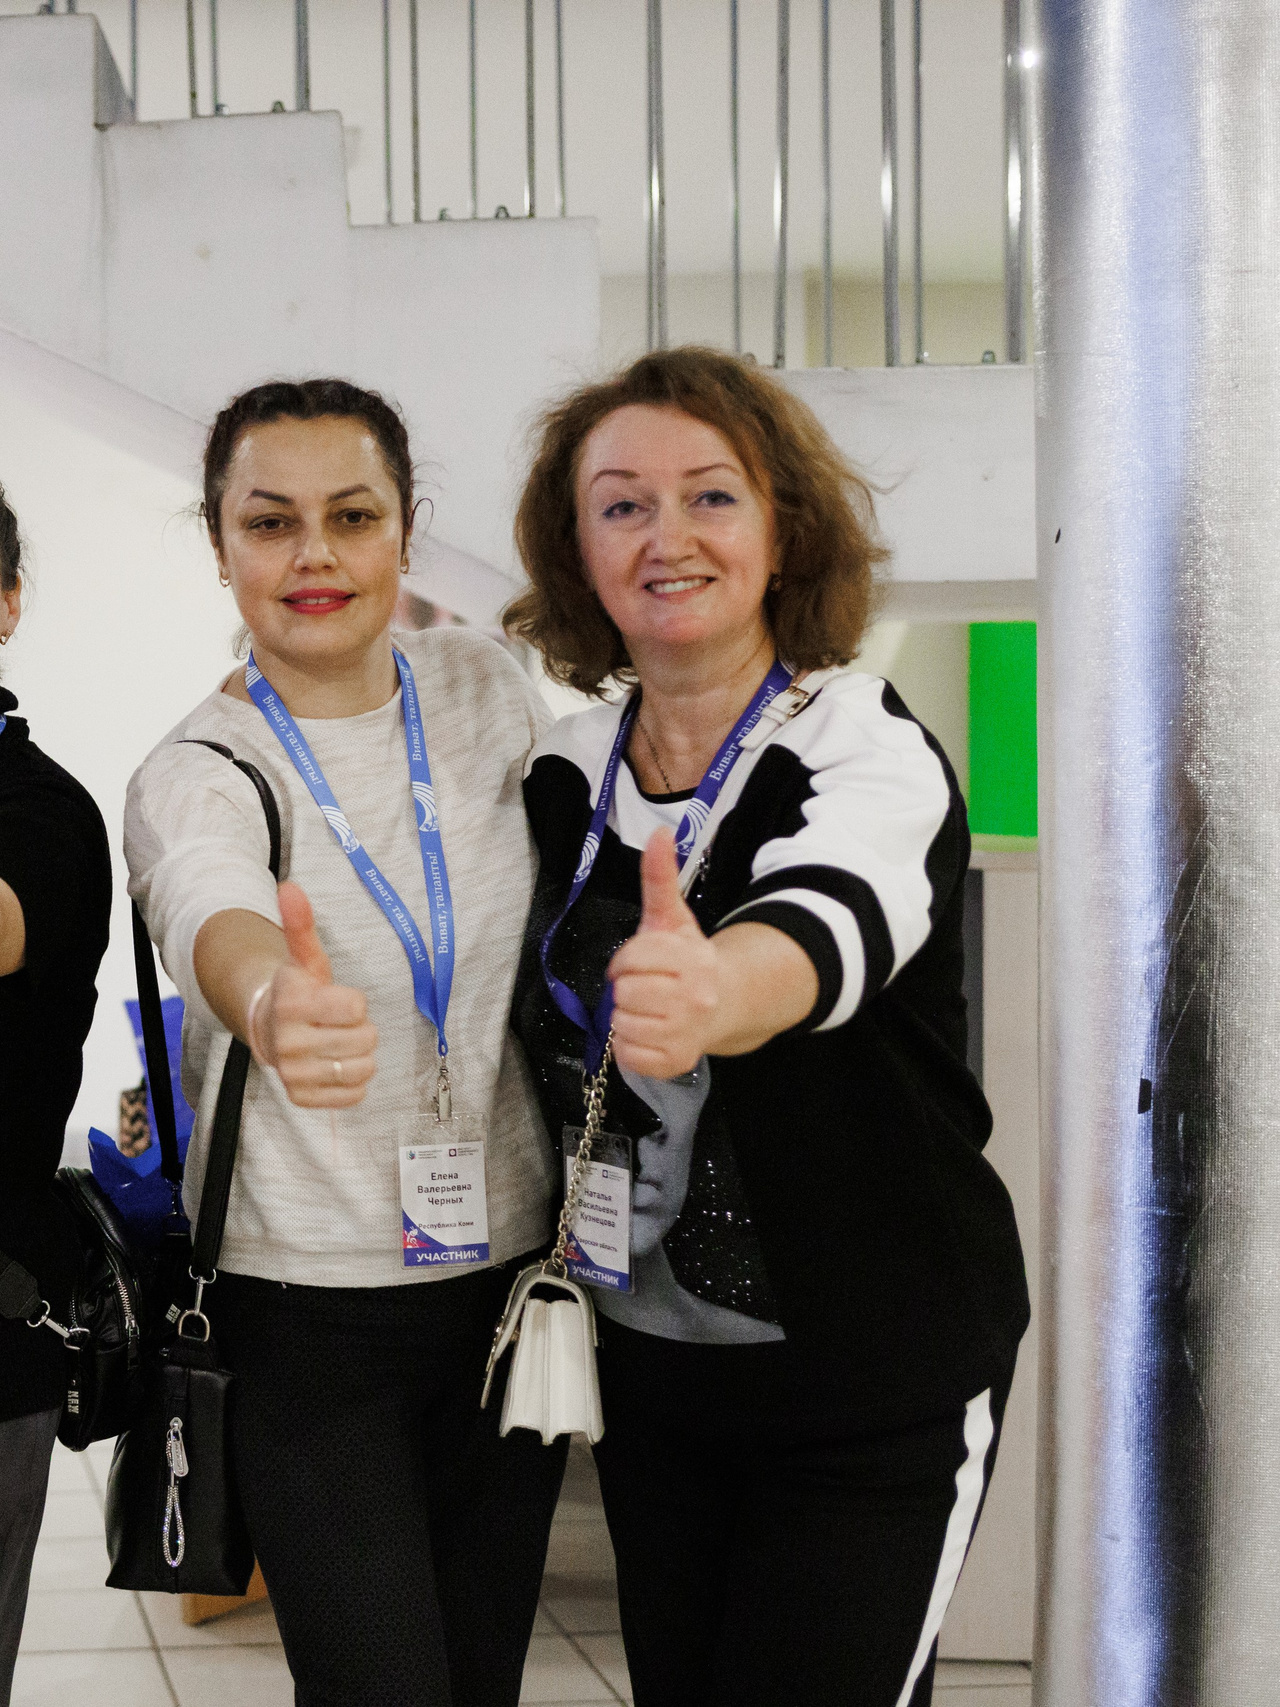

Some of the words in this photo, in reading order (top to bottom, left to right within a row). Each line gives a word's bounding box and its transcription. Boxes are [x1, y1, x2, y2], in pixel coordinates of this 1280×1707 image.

[401, 664, 416, 721] таланты!
[262, 694, 288, 732] Виват,
[285, 730, 324, 787] таланты!
[411, 720, 423, 762] Виват,
[425, 851, 447, 911] таланты!
[365, 868, 393, 907] Виват,
[391, 903, 426, 964] таланты!
[437, 909, 449, 954] Виват,
[431, 1172, 459, 1181] Елена
[417, 1183, 472, 1194] Валерьевна
[584, 1188, 613, 1201] Наталья
[428, 1196, 464, 1207] Черных
[578, 1199, 619, 1216] Васильевна
[418, 1221, 457, 1230] Республика
[458, 1220, 474, 1228] Коми
[580, 1211, 616, 1228] Кузнецова
[417, 1249, 480, 1263] УЧАСТНИК
[572, 1265, 620, 1286] УЧАСТНИК
